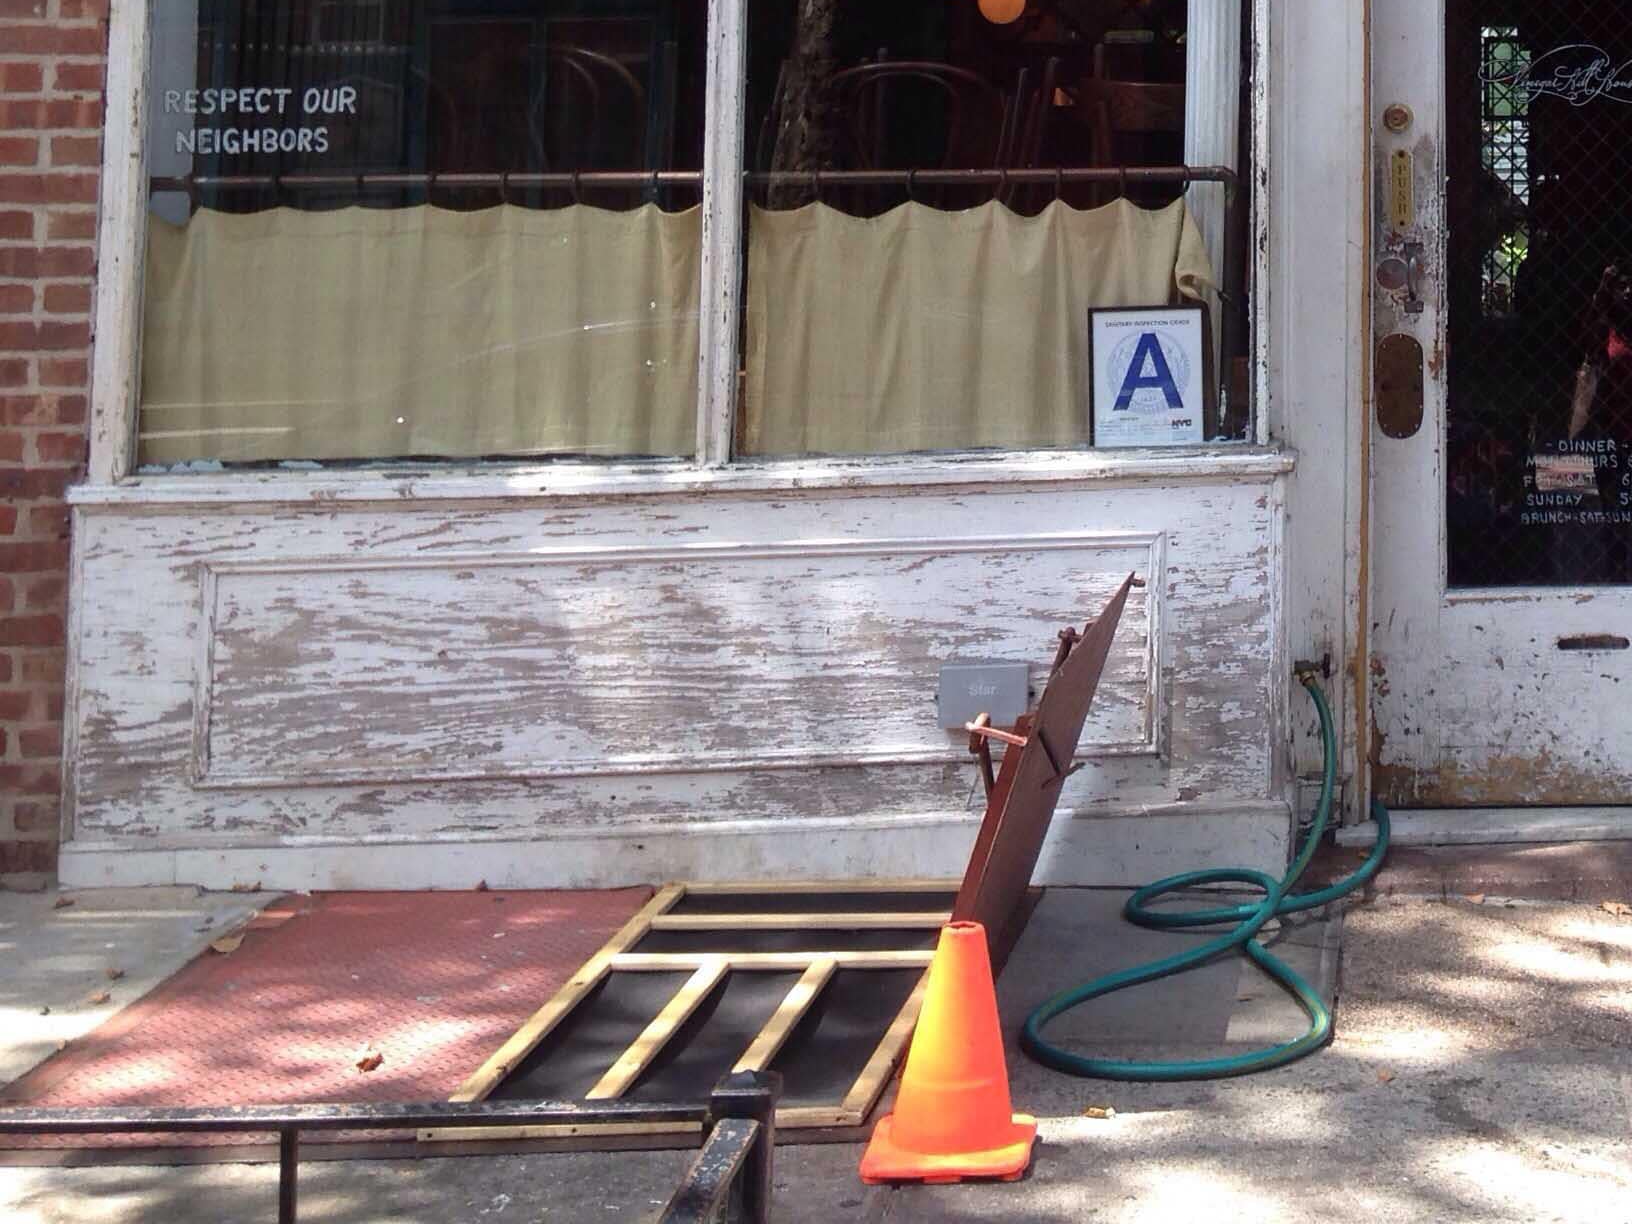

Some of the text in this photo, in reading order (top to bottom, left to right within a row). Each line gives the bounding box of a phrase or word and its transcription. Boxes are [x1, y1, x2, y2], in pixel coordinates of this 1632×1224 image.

[164, 86, 357, 114] RESPECT OUR
[176, 127, 329, 154] NEIGHBORS
[1398, 164, 1407, 214] PUSH
[1113, 332, 1184, 411] A
[1558, 439, 1617, 453] DINNER
[1527, 494, 1583, 506] SUNDAY
